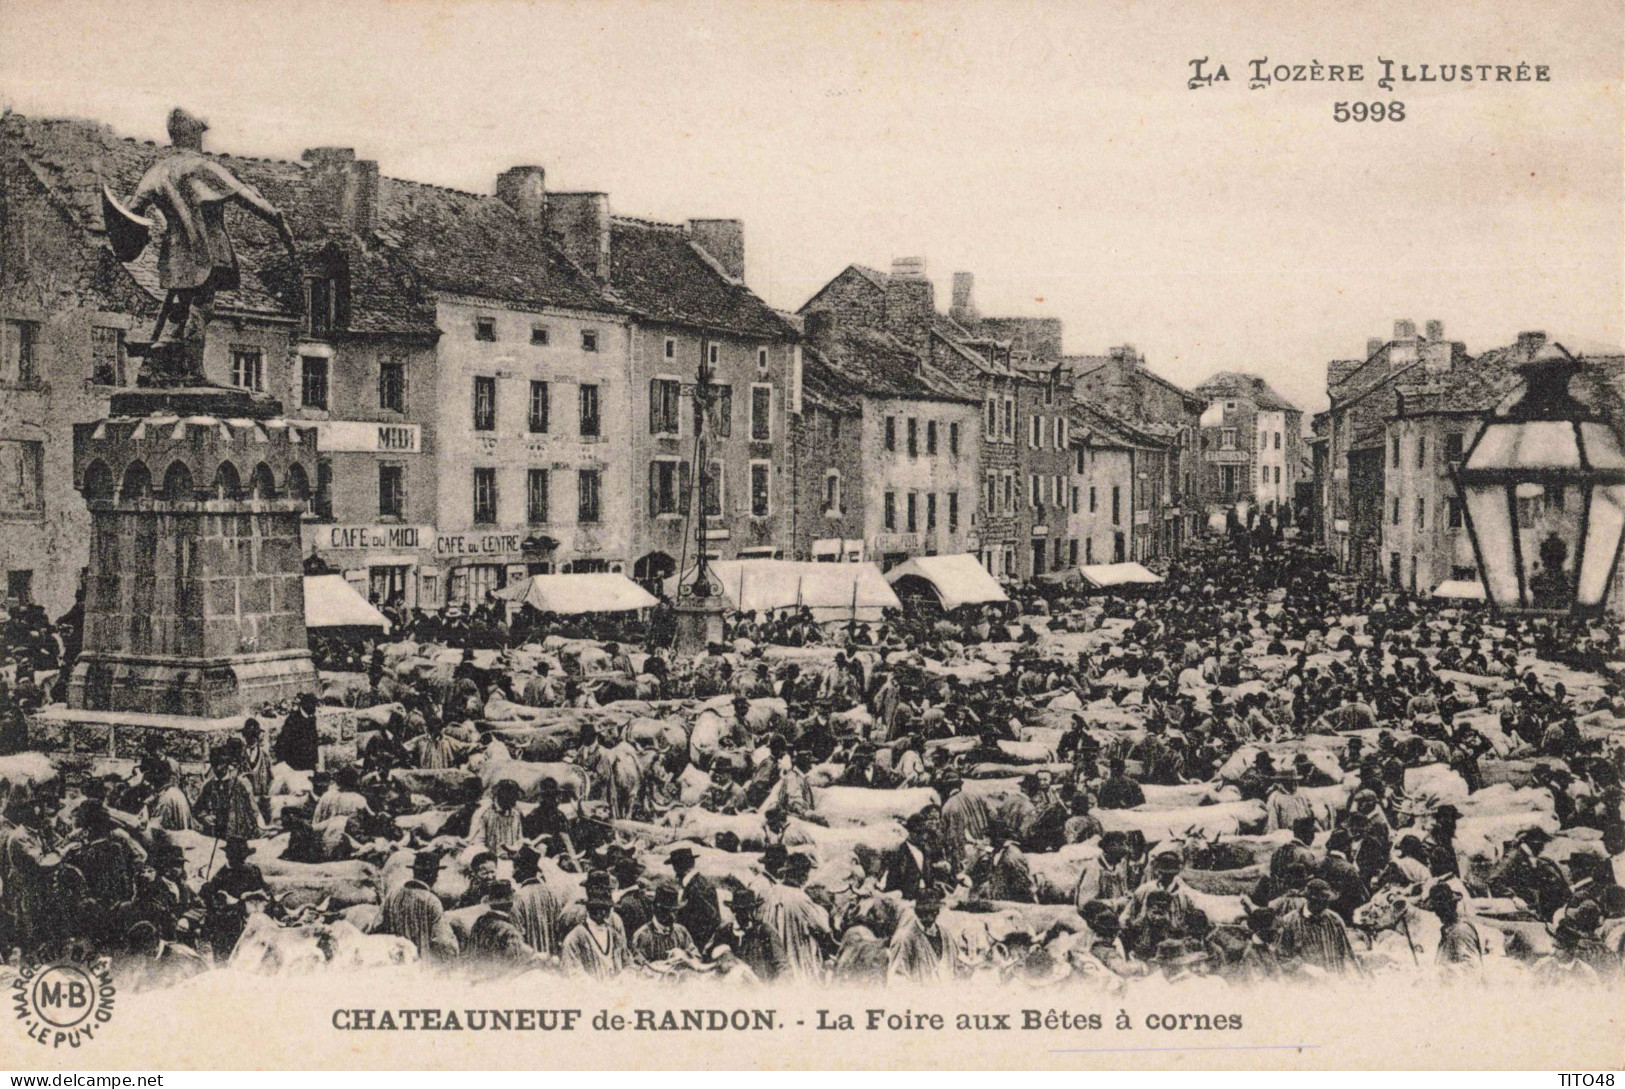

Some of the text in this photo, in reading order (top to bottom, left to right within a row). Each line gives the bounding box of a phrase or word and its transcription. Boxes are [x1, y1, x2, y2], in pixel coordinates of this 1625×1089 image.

[378, 426, 415, 450] MIDI
[330, 527, 369, 548] CAFE
[388, 528, 420, 548] MIDI
[436, 535, 465, 554] CAFE
[481, 534, 519, 552] CENTRE
